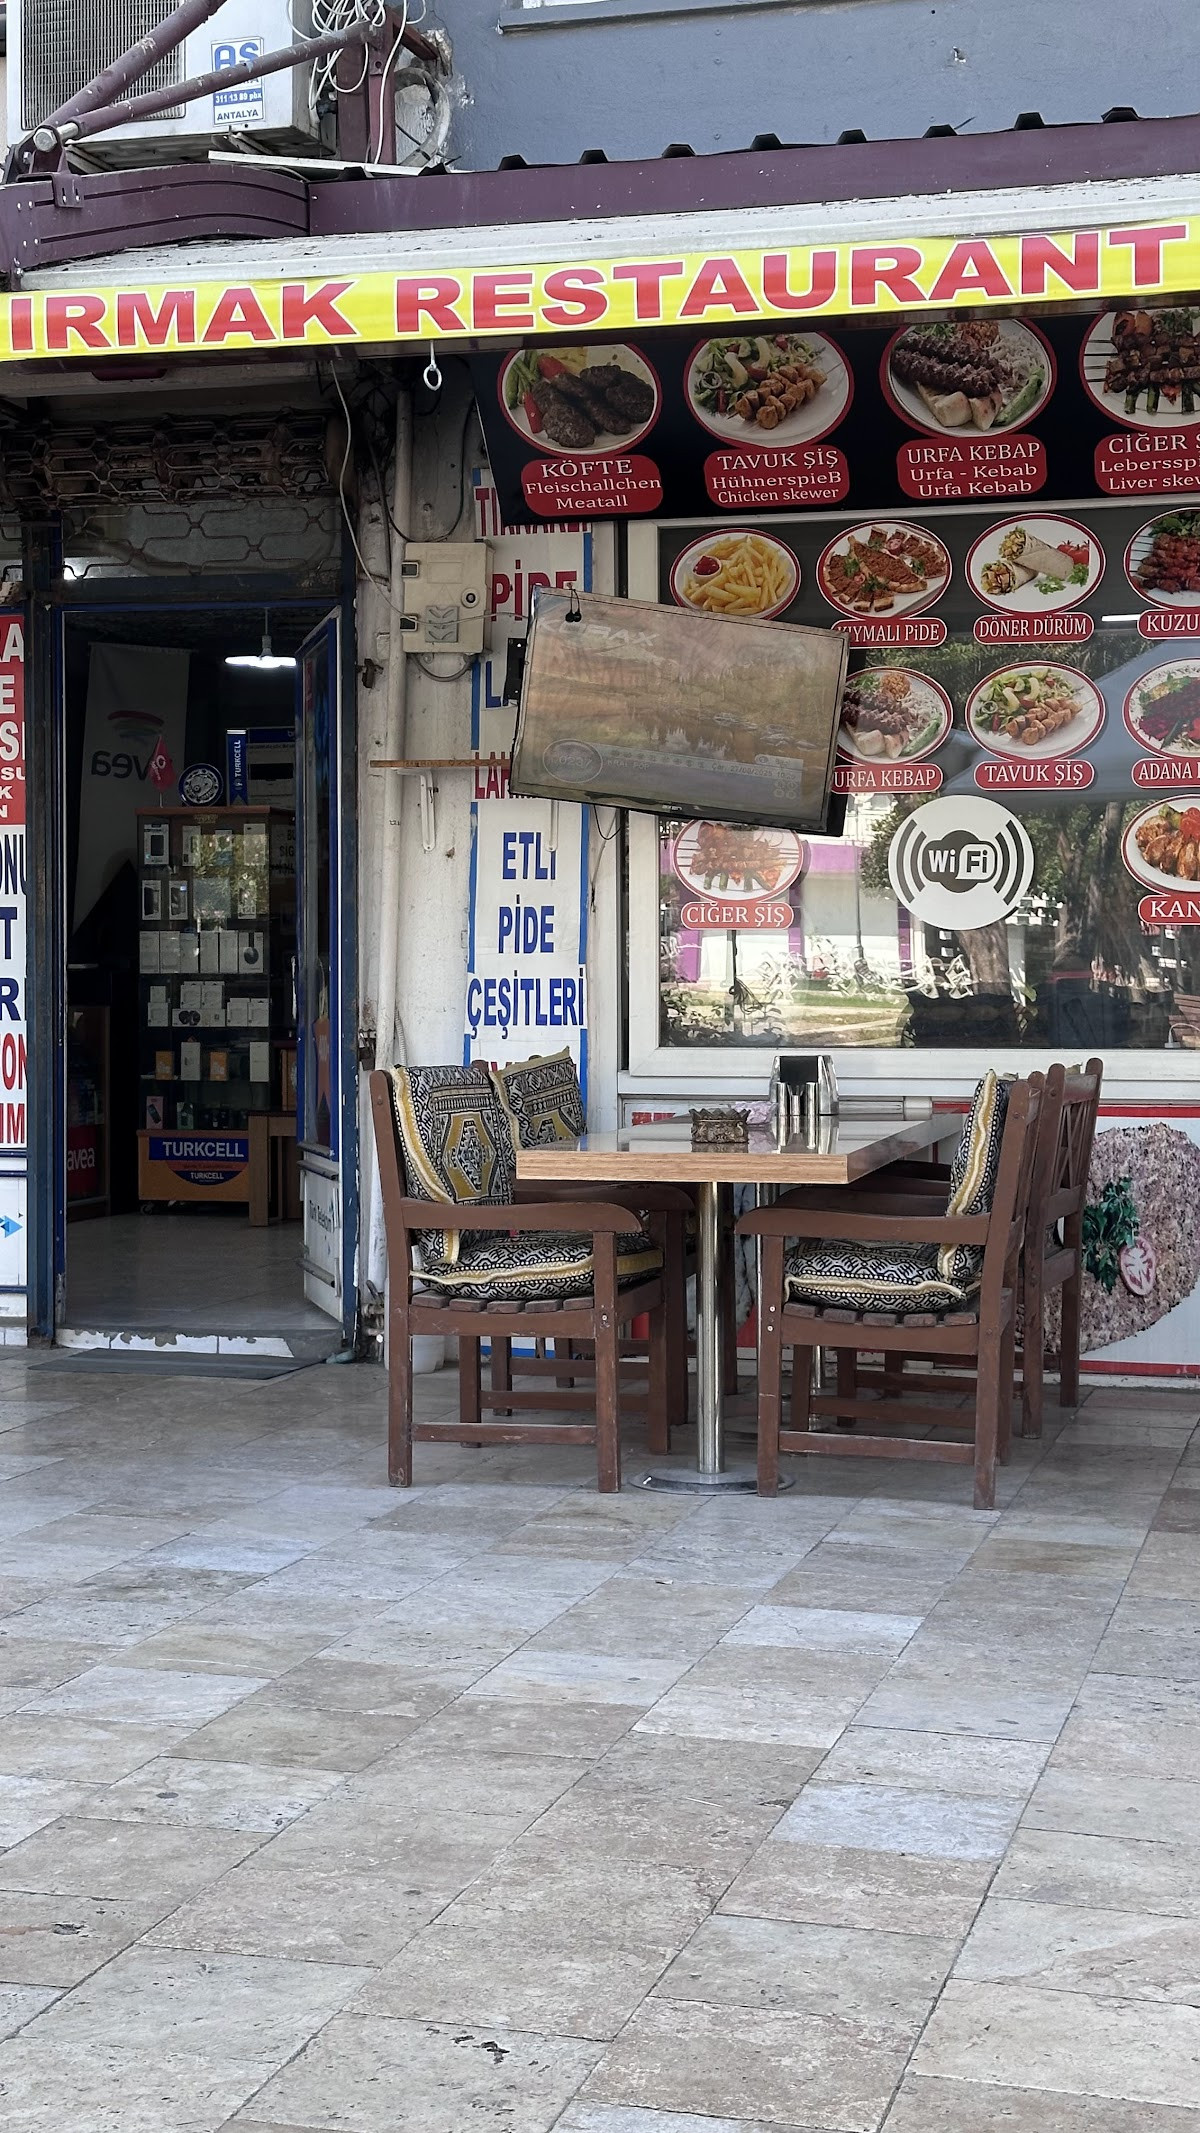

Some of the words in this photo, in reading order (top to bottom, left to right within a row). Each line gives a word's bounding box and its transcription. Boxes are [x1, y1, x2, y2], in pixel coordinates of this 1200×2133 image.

[215, 94, 228, 103] 311
[216, 109, 259, 121] ANTALYA
[10, 280, 358, 351] IRMAK
[396, 225, 1187, 333] RESTAURANT
[907, 447, 964, 464] URFA
[969, 442, 1040, 461] KEBAP
[1108, 432, 1188, 454] CİĞER
[541, 459, 633, 479] KÖFTE
[717, 452, 798, 470] TAVUK
[803, 448, 838, 469] ŞİŞ
[910, 467, 954, 481] Urfa
[973, 463, 1037, 478] Kebab
[525, 478, 662, 494] Fleischallchen
[918, 483, 962, 497] Urfa
[968, 480, 1032, 495] Kebab
[1109, 477, 1158, 490] Liver
[556, 494, 628, 510] Meatall
[718, 490, 779, 504] Chicken
[782, 487, 839, 501] skewer
[491, 559, 577, 622] Pİ
[979, 617, 1030, 637] DÖNER
[1033, 614, 1087, 636] DÜRÜM
[1146, 613, 1200, 632] KUZU
[838, 623, 900, 643] YMALI
[233, 739, 242, 778] TURKCELL
[833, 770, 877, 788] URFA
[880, 769, 936, 787] KEBAP
[984, 764, 1050, 783] TAVUK
[1054, 760, 1084, 785] ŞİŞ
[1138, 761, 1194, 780] ADANA
[499, 894, 555, 953] PİDE
[686, 902, 750, 924] CİĞER
[754, 904, 786, 927] ŞİŞ
[467, 967, 584, 1040] ÇEŞİTLERİ
[66, 1147, 96, 1172] avea
[162, 1141, 245, 1158] TURKCELL
[190, 1172, 225, 1181] TURKCELL
